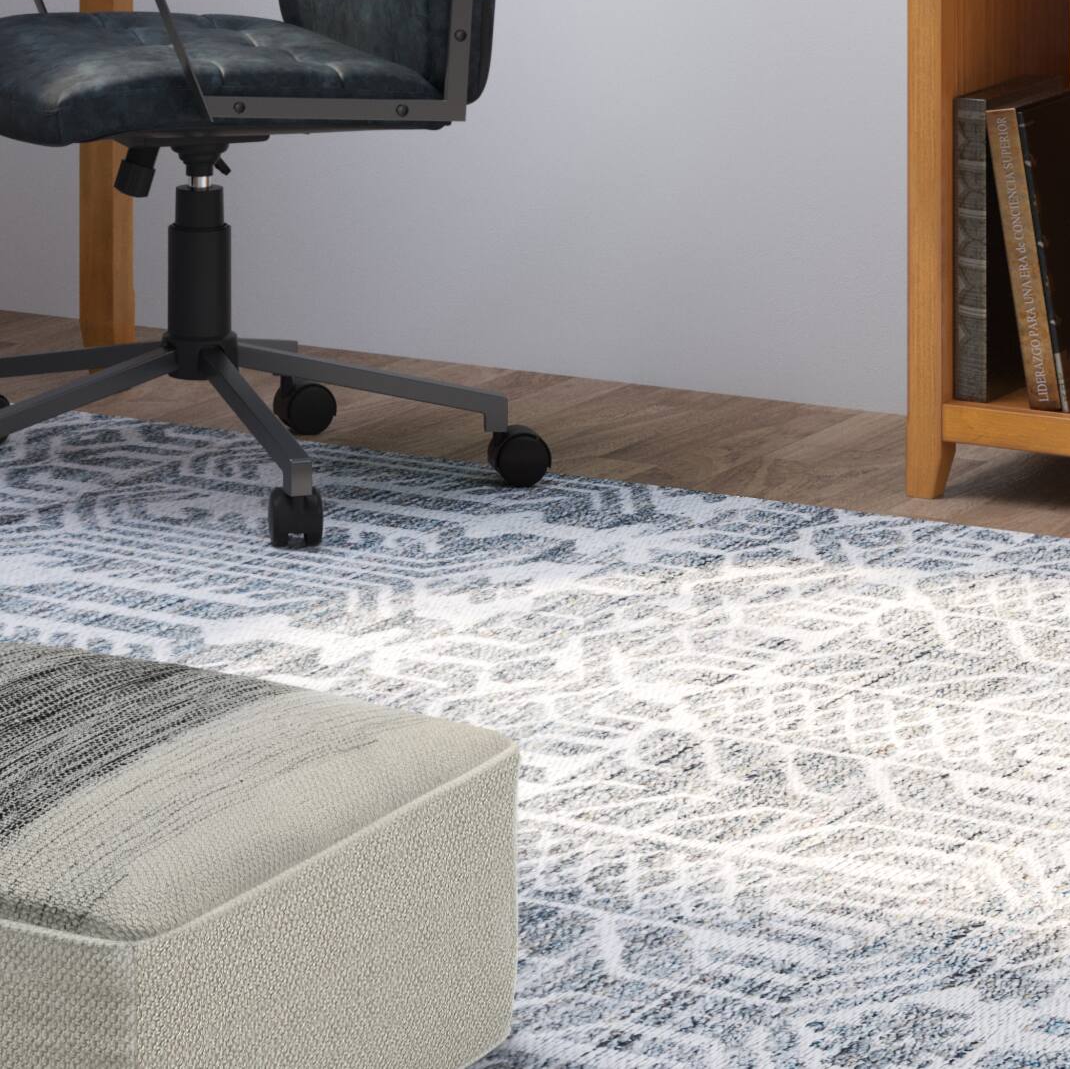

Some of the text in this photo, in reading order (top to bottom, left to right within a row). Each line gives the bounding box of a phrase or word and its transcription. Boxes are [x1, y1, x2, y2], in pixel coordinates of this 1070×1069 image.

[996, 116, 1049, 402] LIDERAZGO PARA UNA ERA de CONCIENCIA SUPERIOR
